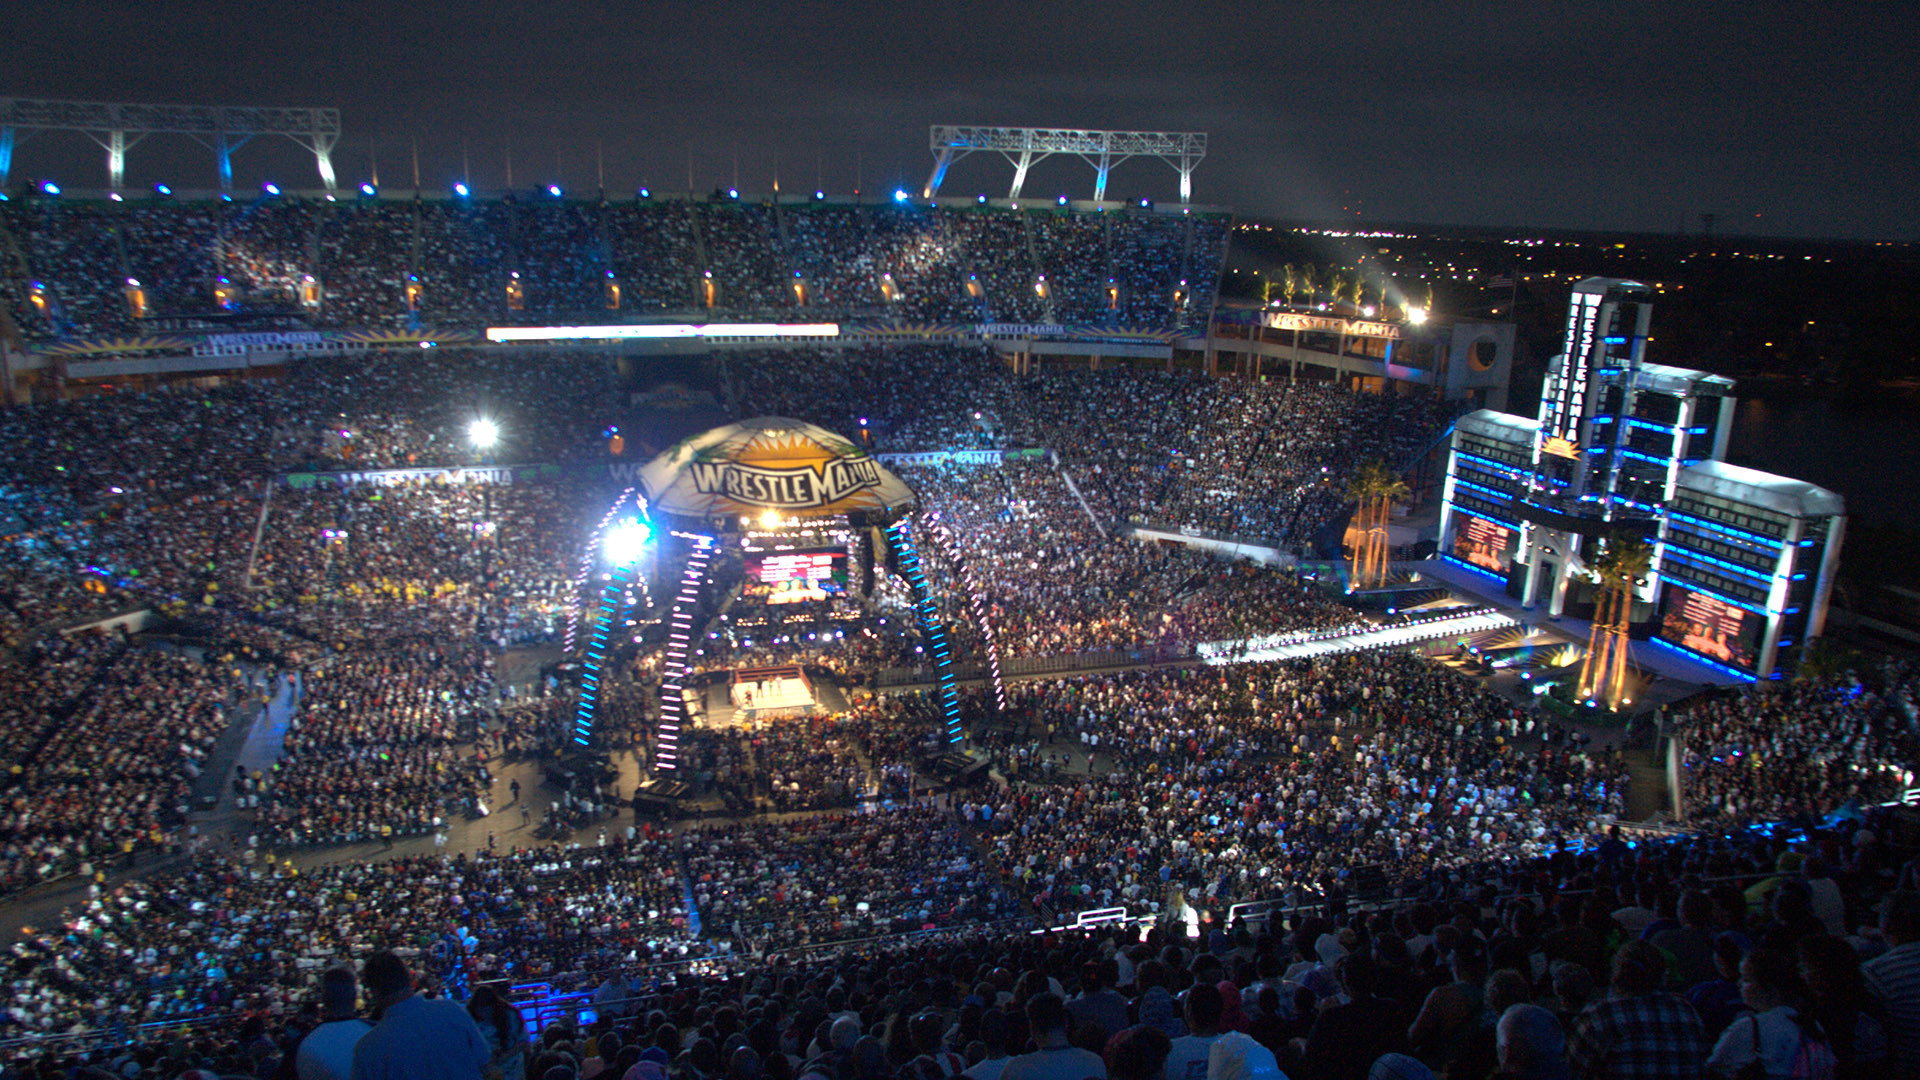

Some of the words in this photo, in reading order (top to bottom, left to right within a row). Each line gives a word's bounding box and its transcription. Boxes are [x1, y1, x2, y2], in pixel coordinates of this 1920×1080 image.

[974, 323, 1064, 334] WRESTLEMANIA
[1259, 311, 1400, 338] WRESTLEMANIA
[1551, 292, 1583, 437] WRESTLEMANIA
[1565, 293, 1603, 441] WRESTLEMANIA
[690, 456, 881, 508] WRESTLEMANIA
